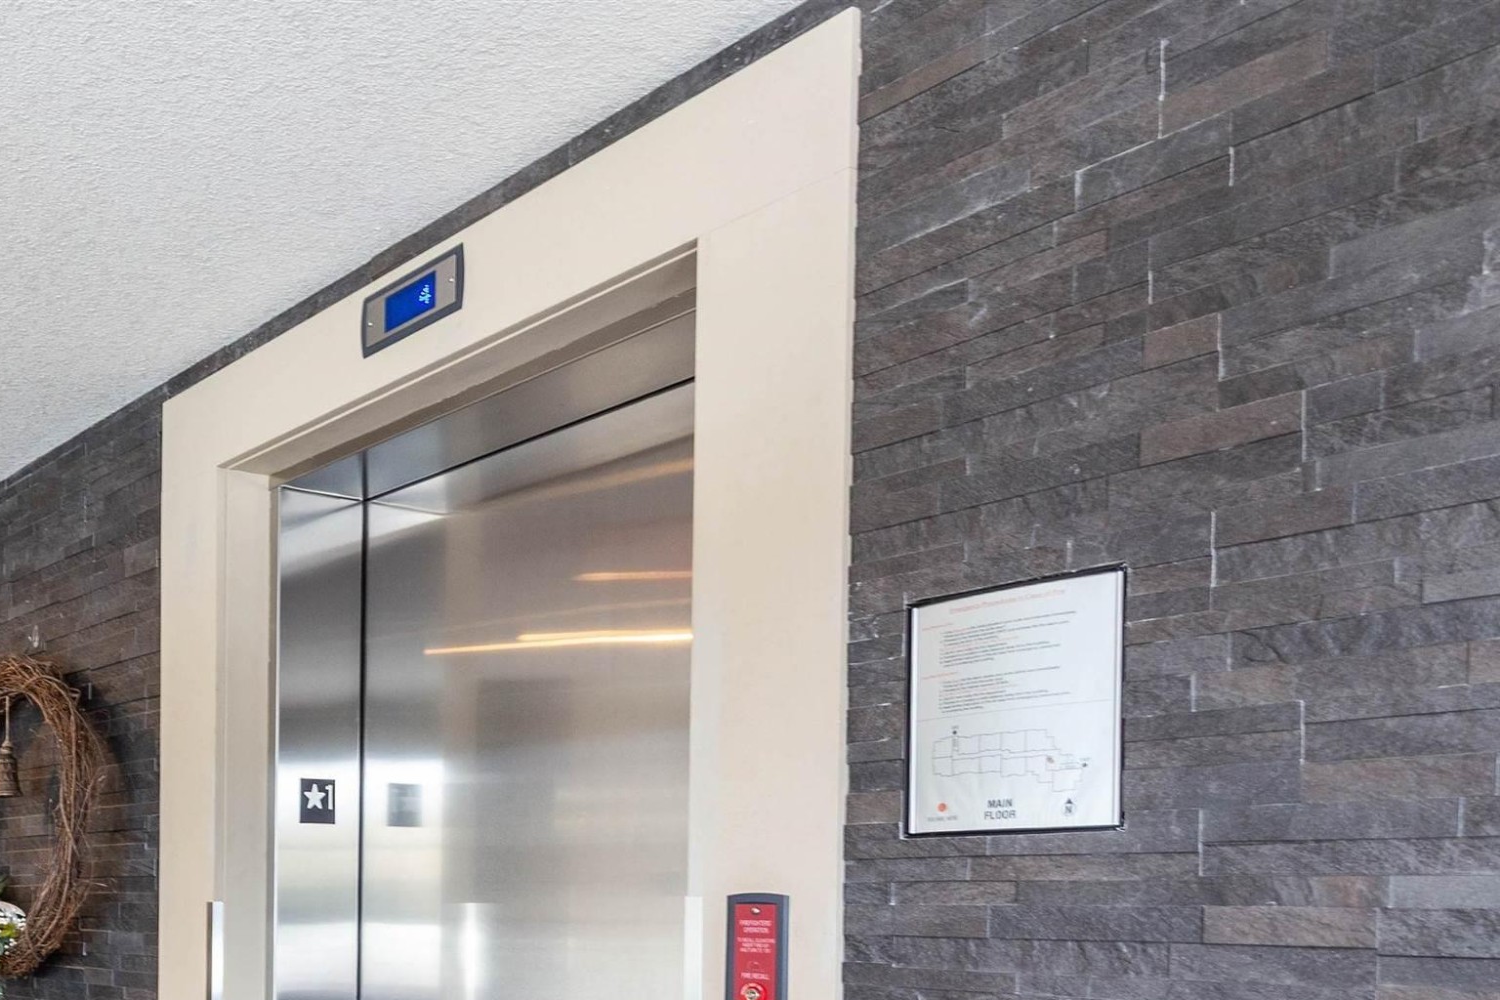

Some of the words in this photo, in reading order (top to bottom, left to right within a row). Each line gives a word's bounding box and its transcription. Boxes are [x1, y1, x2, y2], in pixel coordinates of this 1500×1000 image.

[325, 784, 334, 810] 1
[986, 798, 1013, 809] MAIN
[983, 809, 1017, 820] FLOOR
